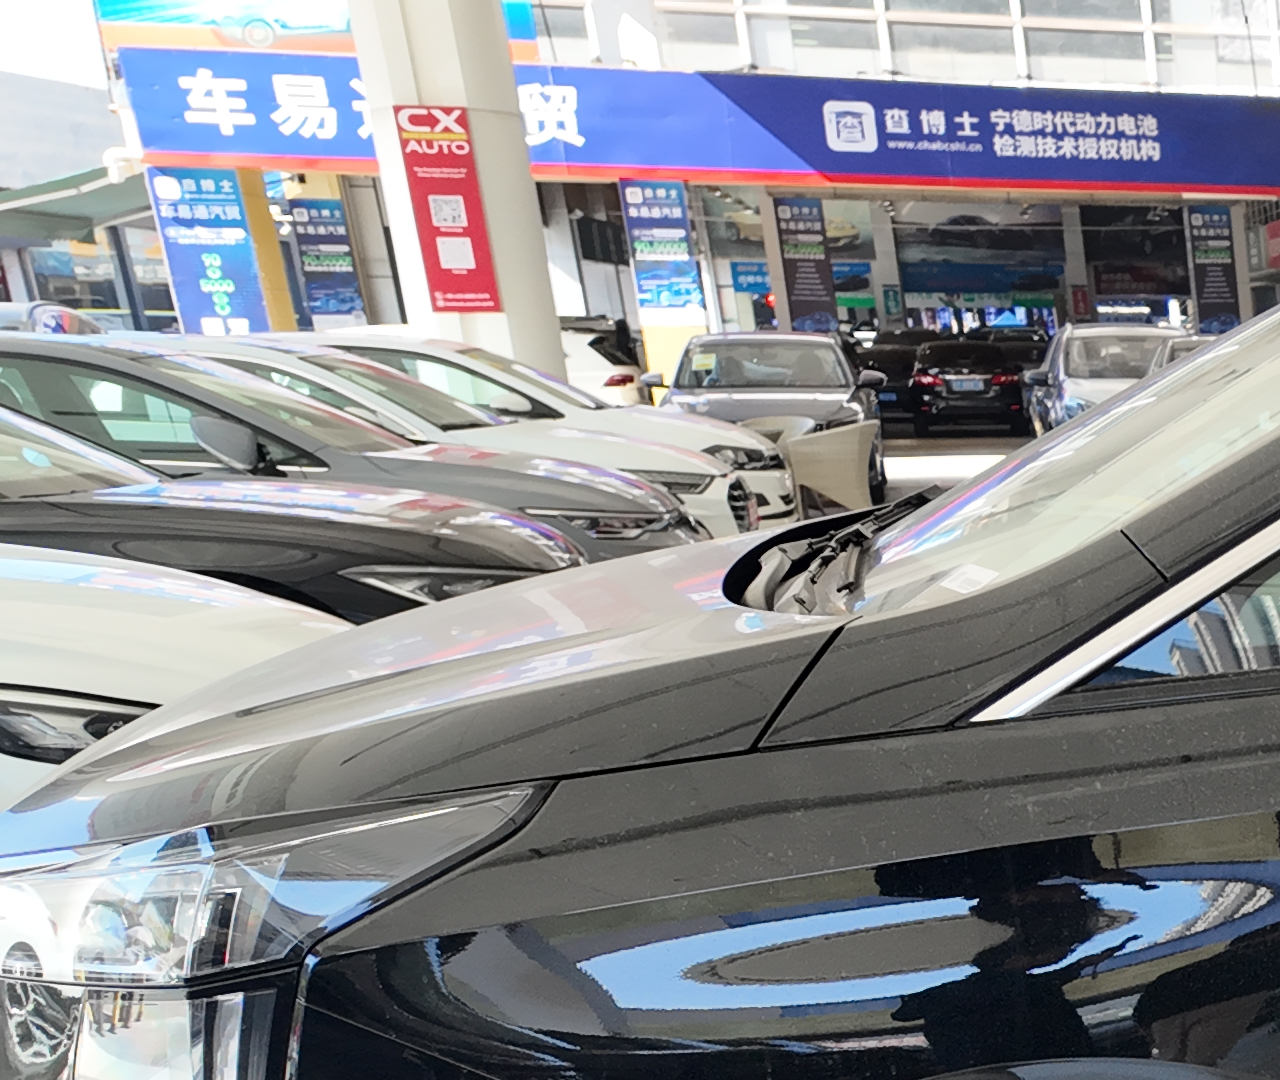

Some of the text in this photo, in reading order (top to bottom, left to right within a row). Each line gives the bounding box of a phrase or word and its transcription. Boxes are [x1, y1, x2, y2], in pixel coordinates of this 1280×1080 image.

[397, 108, 466, 133] CX
[884, 108, 980, 137] 查博士
[990, 109, 1158, 136] 宁德时代动力电池
[404, 140, 470, 155] AUTO
[993, 134, 1161, 162] 检测技术授权机构
